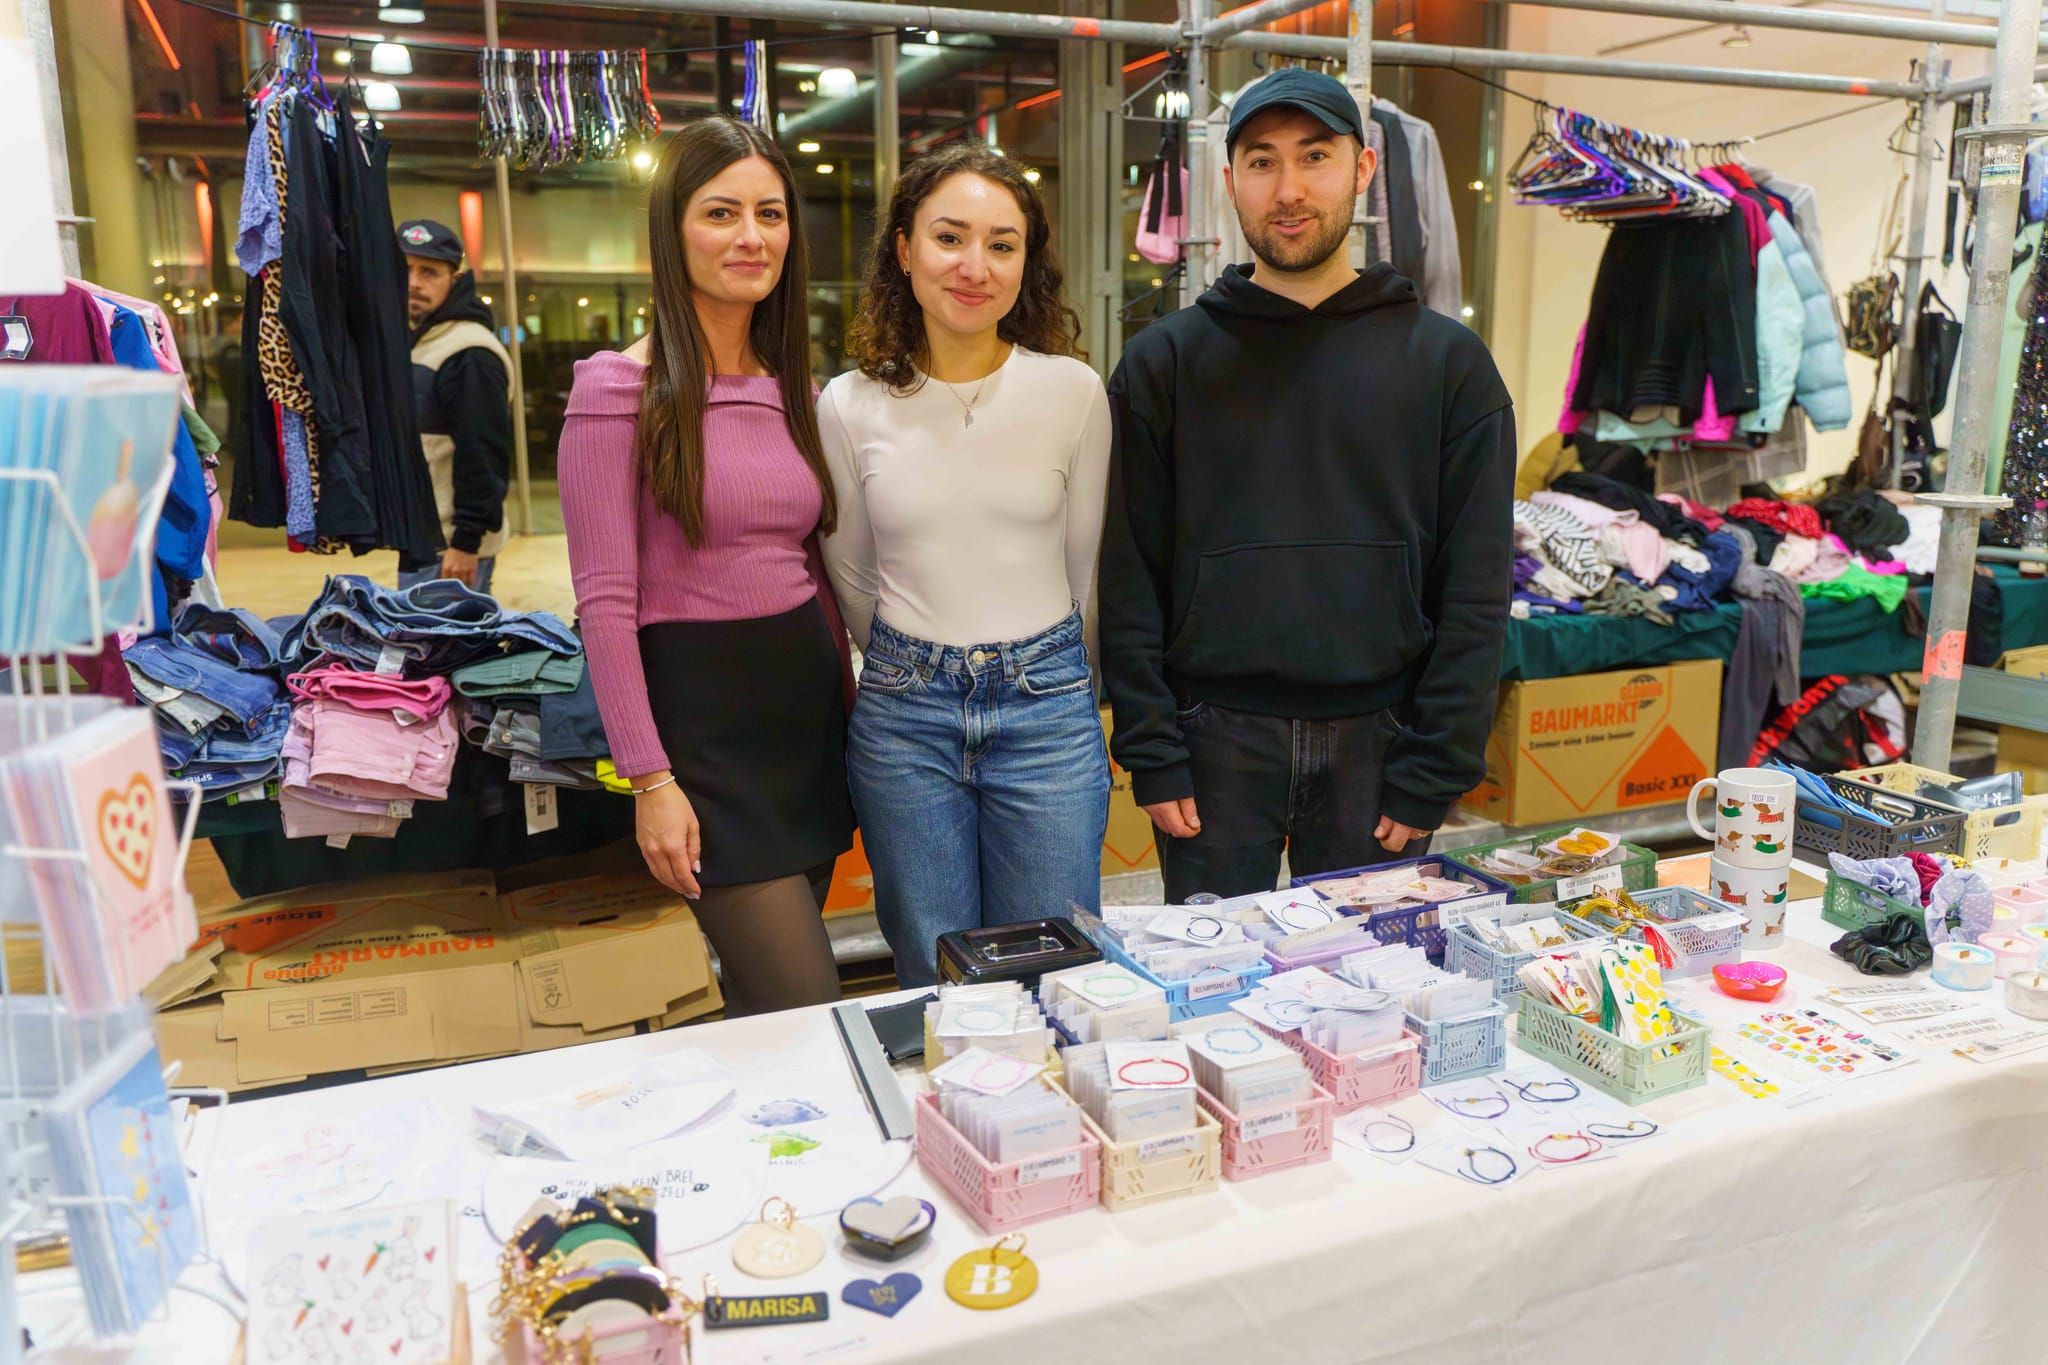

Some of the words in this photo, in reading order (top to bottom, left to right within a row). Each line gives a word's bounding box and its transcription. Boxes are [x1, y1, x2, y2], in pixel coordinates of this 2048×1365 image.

[1530, 700, 1640, 735] BAUMARKT
[1625, 776, 1665, 797] Basic
[312, 934, 496, 968] BAUMARKT
[263, 963, 345, 981] GLOBUS
[632, 1174, 660, 1188] KEIN
[969, 1263, 1014, 1295] B
[726, 1295, 817, 1321] MARISA
